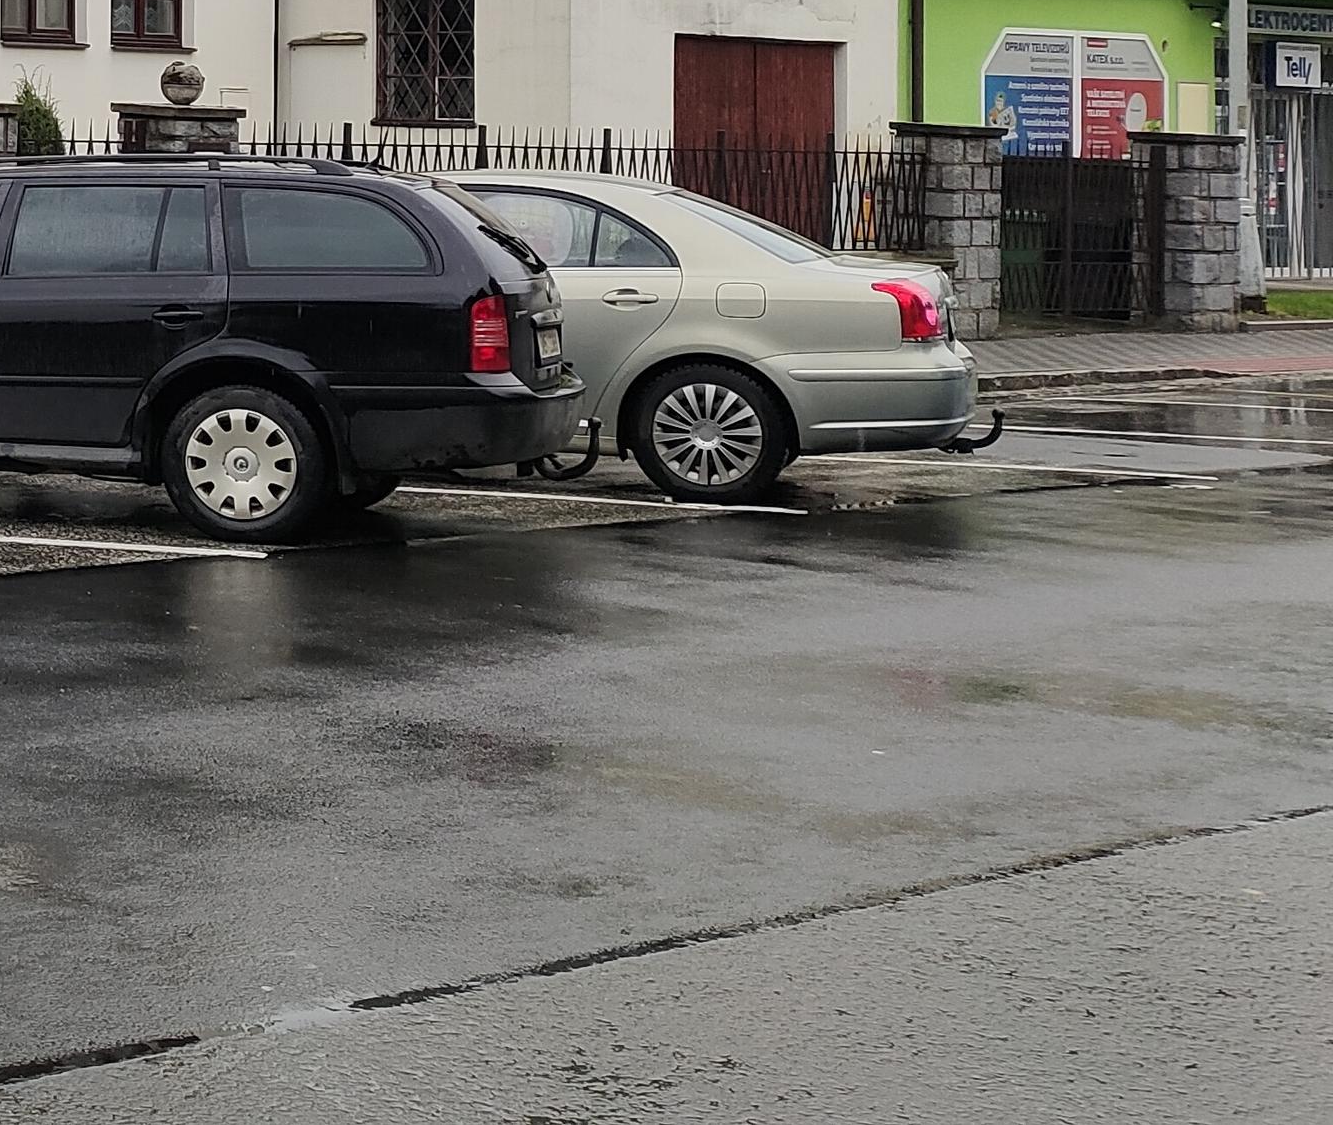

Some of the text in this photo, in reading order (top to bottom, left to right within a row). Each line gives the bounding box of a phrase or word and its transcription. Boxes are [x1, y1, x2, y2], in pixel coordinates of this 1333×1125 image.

[1248, 10, 1333, 32] LEKTROCENT
[1005, 41, 1030, 52] OPRAVY
[1284, 56, 1312, 84] Telly
